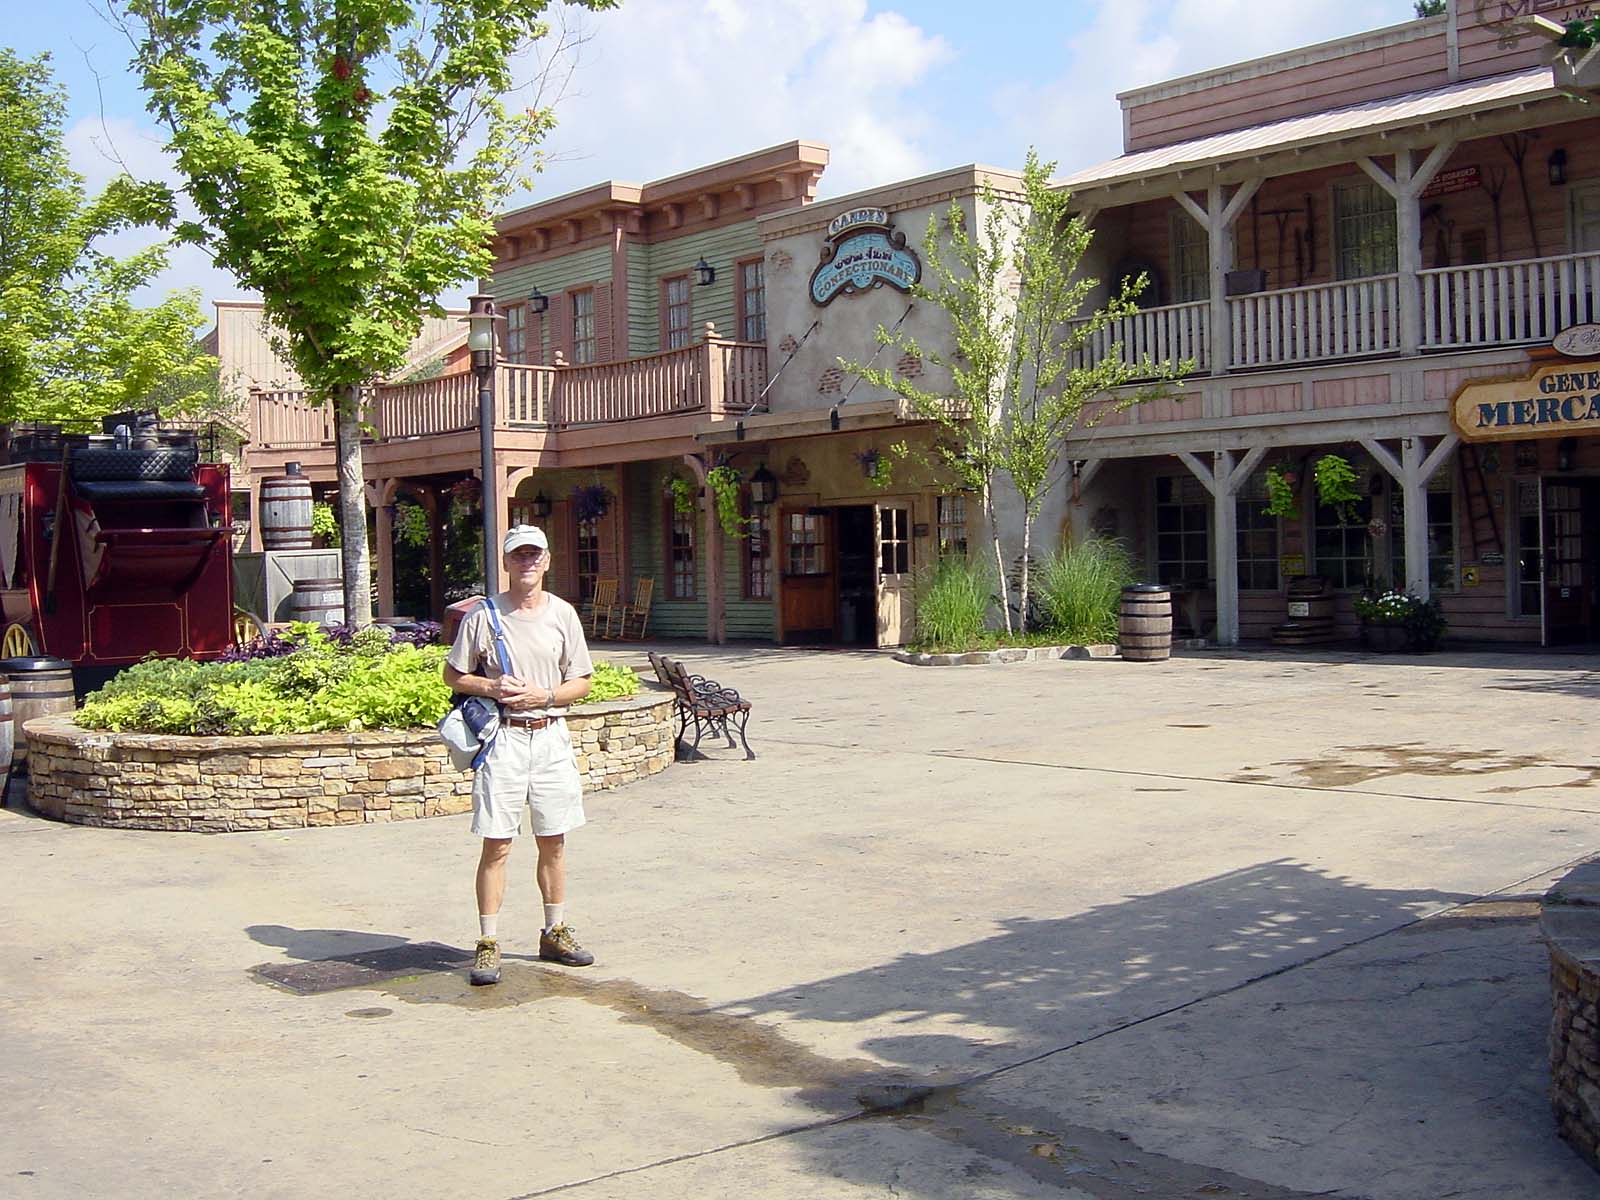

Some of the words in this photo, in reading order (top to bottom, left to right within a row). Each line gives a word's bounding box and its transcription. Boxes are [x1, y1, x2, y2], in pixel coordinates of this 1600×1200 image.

[831, 209, 887, 232] CANDY'S
[818, 260, 913, 298] CONFECTIONARY
[1539, 371, 1600, 394] GENE
[1476, 393, 1600, 428] MERCA
